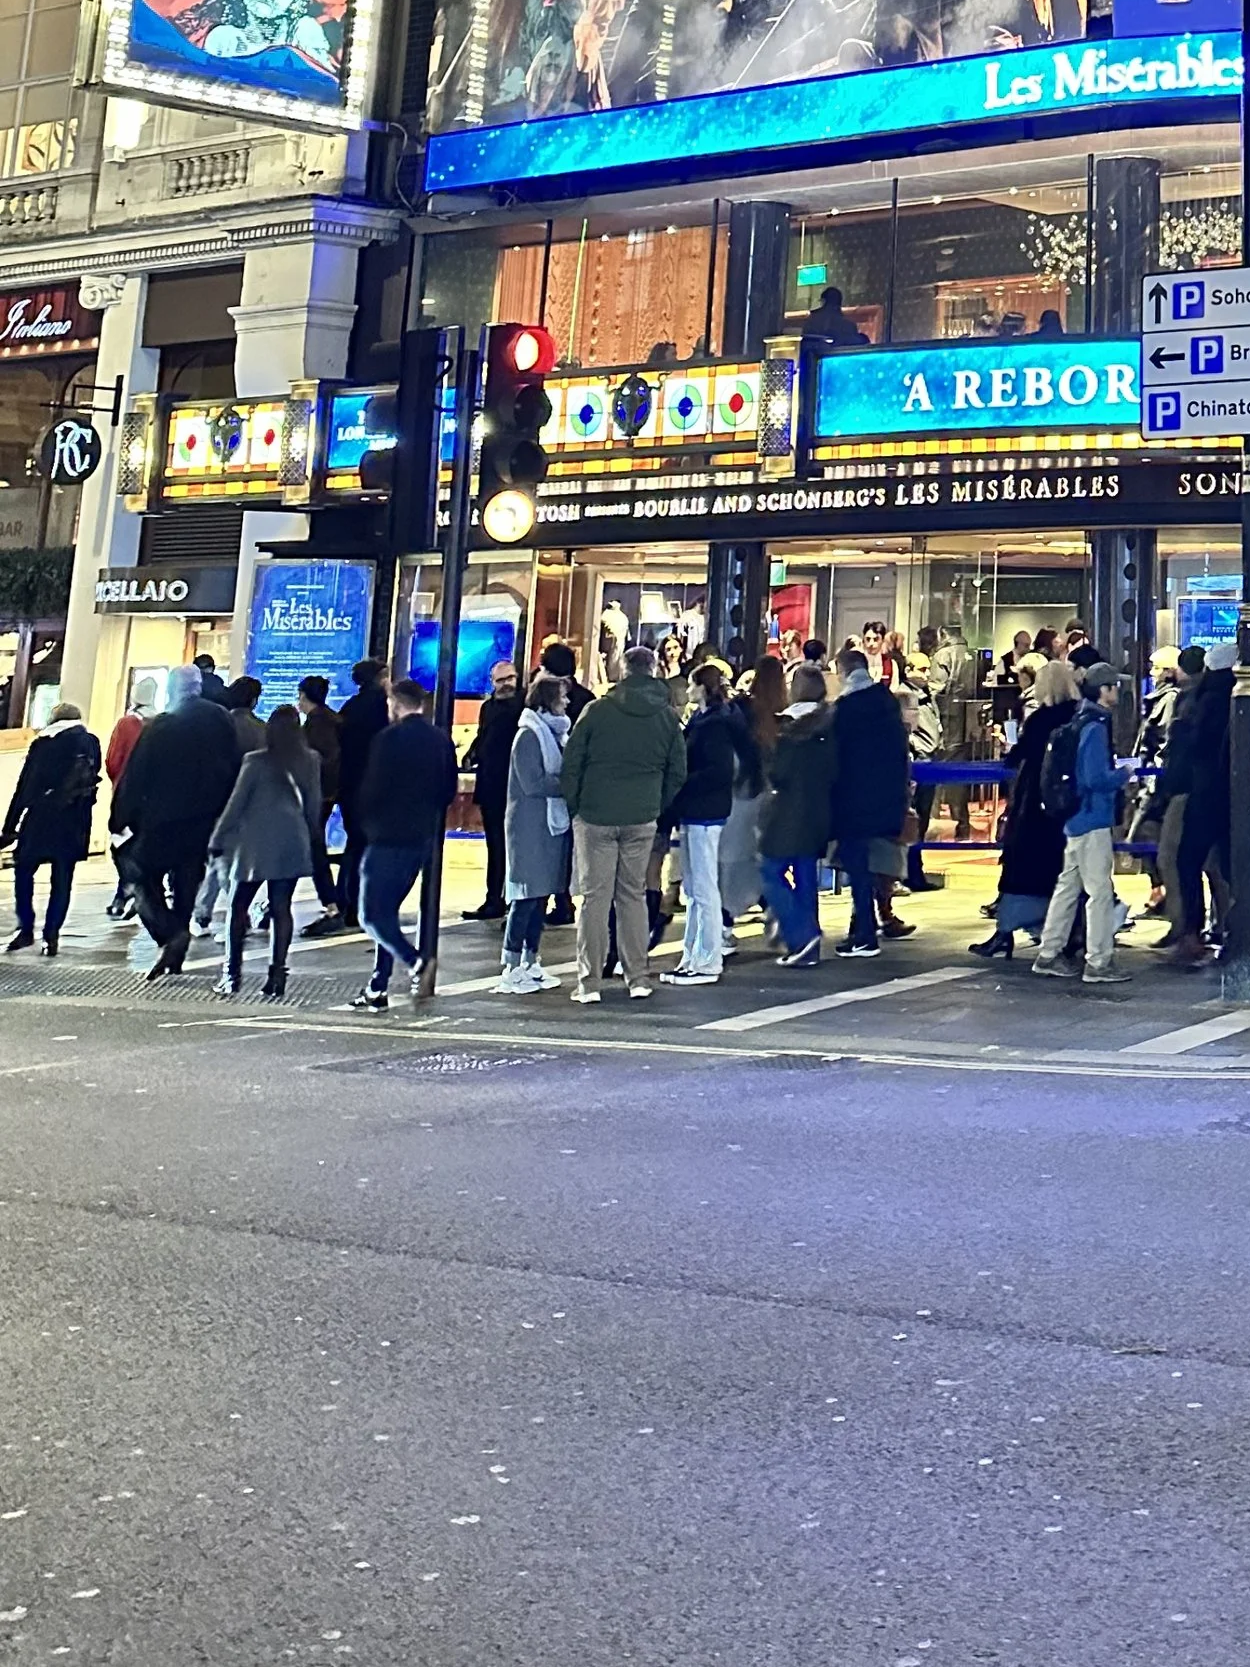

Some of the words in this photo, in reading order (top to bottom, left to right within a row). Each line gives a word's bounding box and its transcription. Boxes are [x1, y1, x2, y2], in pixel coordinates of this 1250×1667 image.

[983, 61, 1045, 111] Les
[1180, 284, 1201, 318] P
[0, 298, 73, 341] Italiano
[1198, 339, 1220, 372] P
[952, 364, 1141, 411] REBOR
[1155, 395, 1177, 429] P
[633, 496, 709, 518] BOUBLIL
[712, 494, 752, 515] AND
[894, 483, 940, 507] LES
[951, 474, 1120, 503] MISÉRABLES
[262, 607, 353, 631] Misérables
[289, 597, 313, 615] Les
